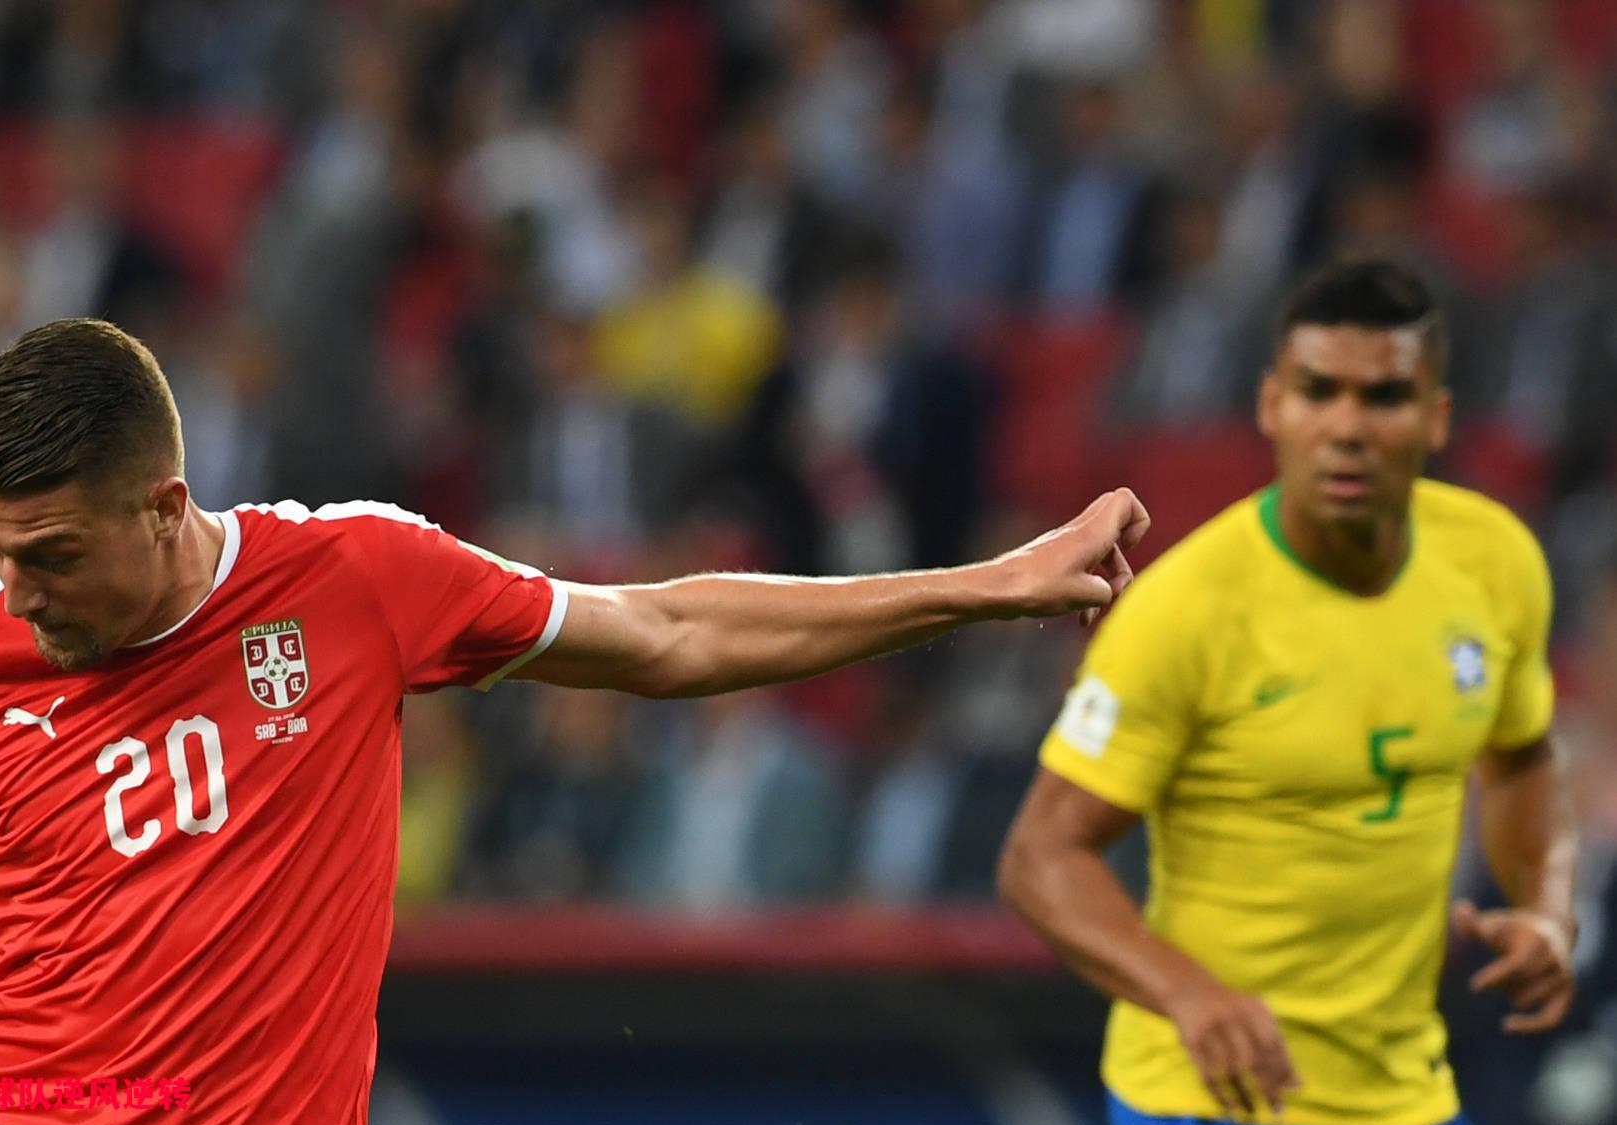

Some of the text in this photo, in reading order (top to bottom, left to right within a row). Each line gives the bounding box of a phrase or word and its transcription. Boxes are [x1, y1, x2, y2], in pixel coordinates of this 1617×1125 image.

[242, 620, 298, 637] СРБИЈА
[255, 723, 277, 741] SRB
[287, 717, 308, 735] BRA
[95, 714, 229, 858] 20
[1360, 726, 1415, 824] 5
